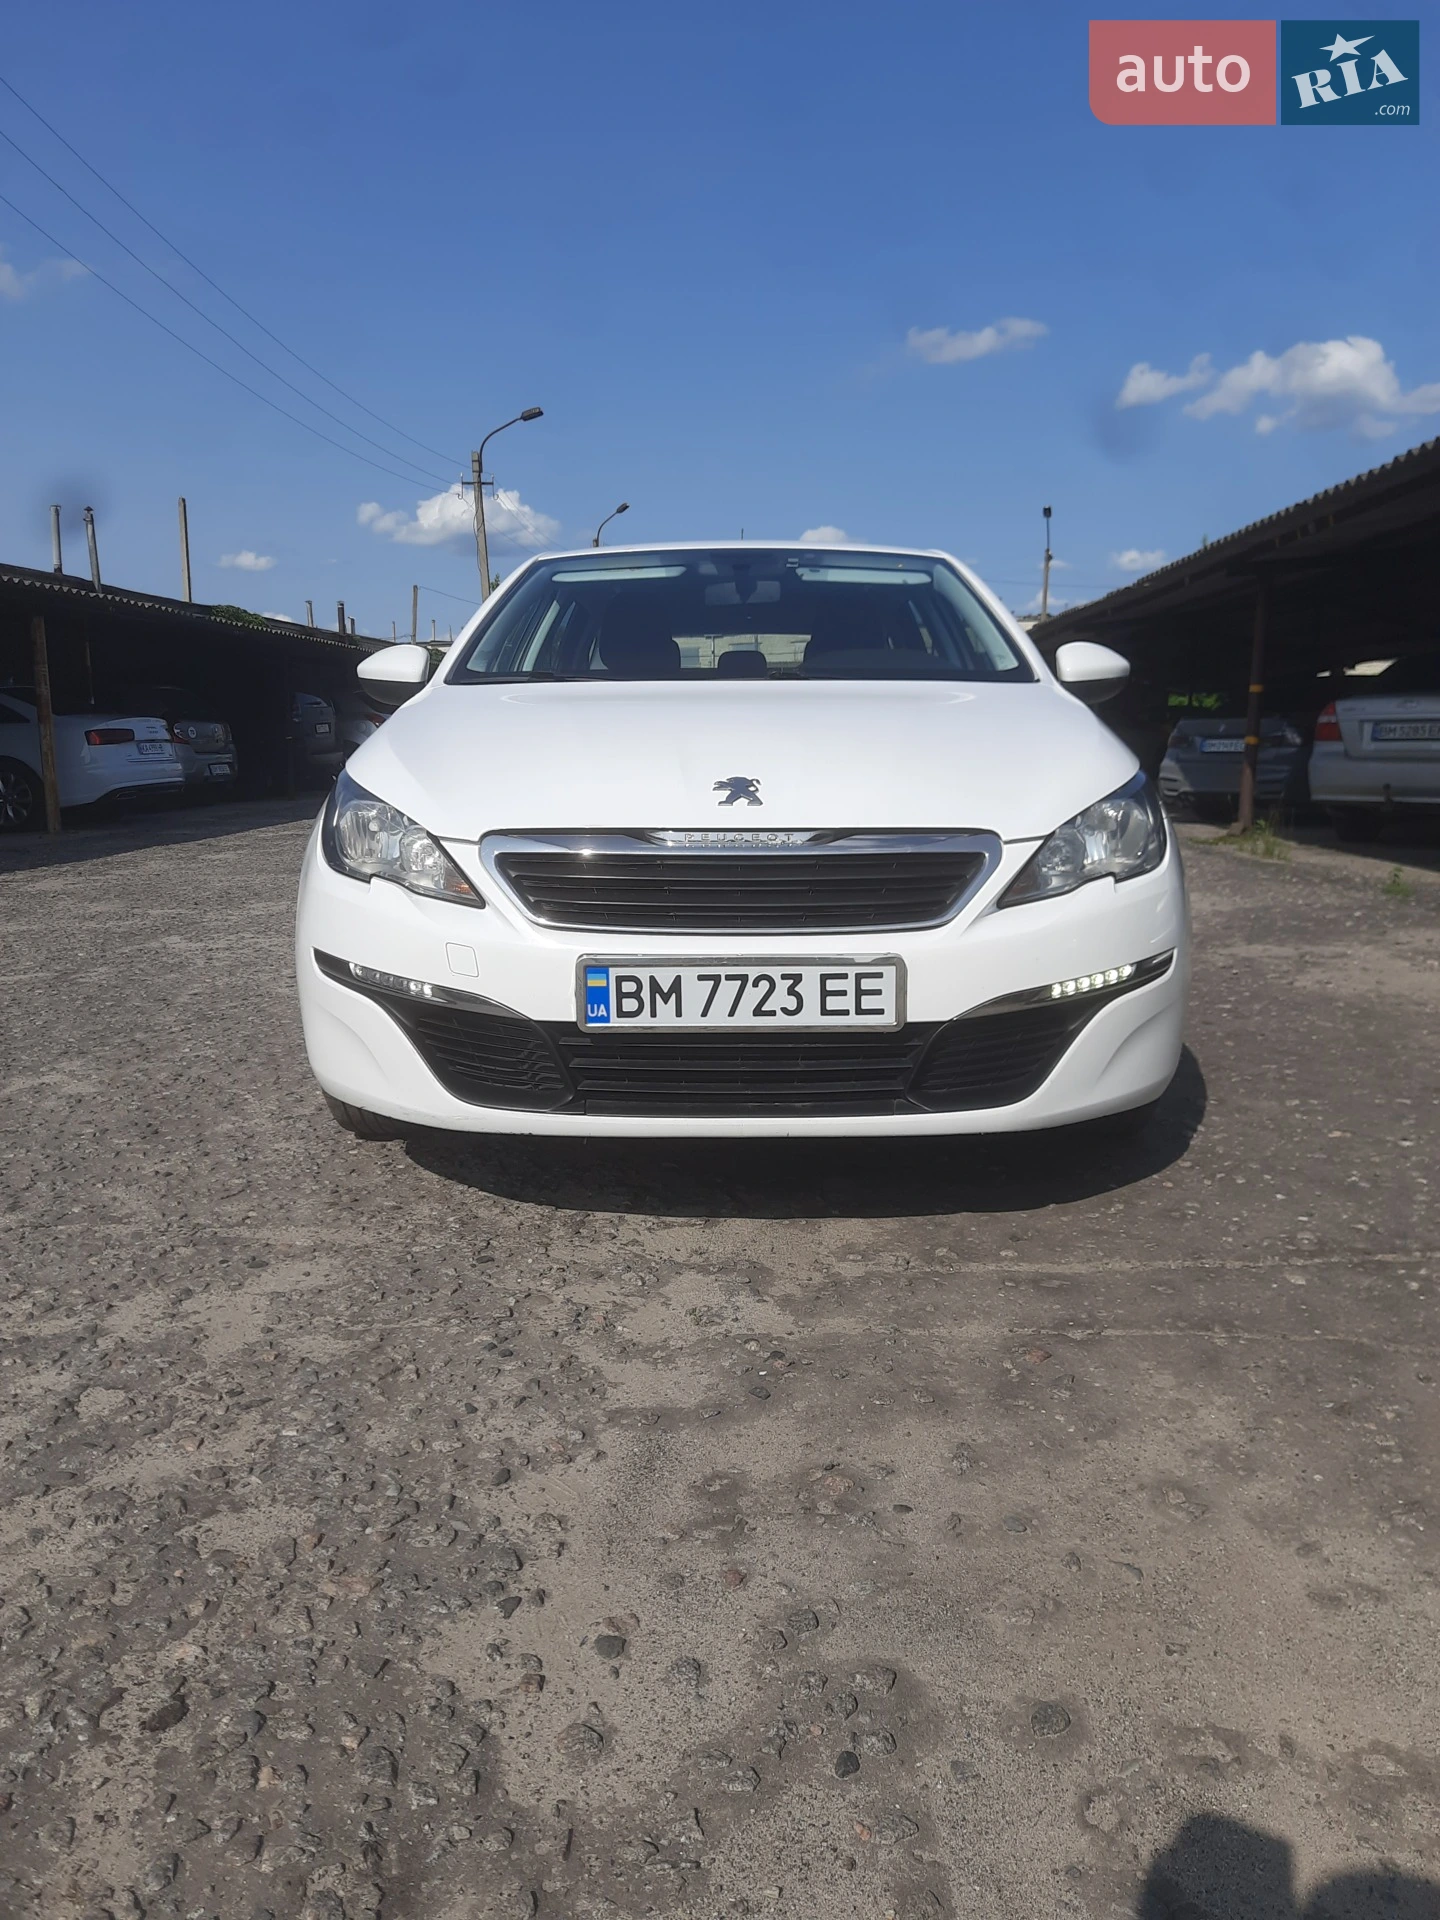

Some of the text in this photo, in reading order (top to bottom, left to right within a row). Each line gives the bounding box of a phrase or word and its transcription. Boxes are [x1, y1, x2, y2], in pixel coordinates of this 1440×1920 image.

[684, 833, 794, 842] PEUGEOT
[614, 972, 886, 1018] BM 7723 EE
[587, 1003, 608, 1018] UA
